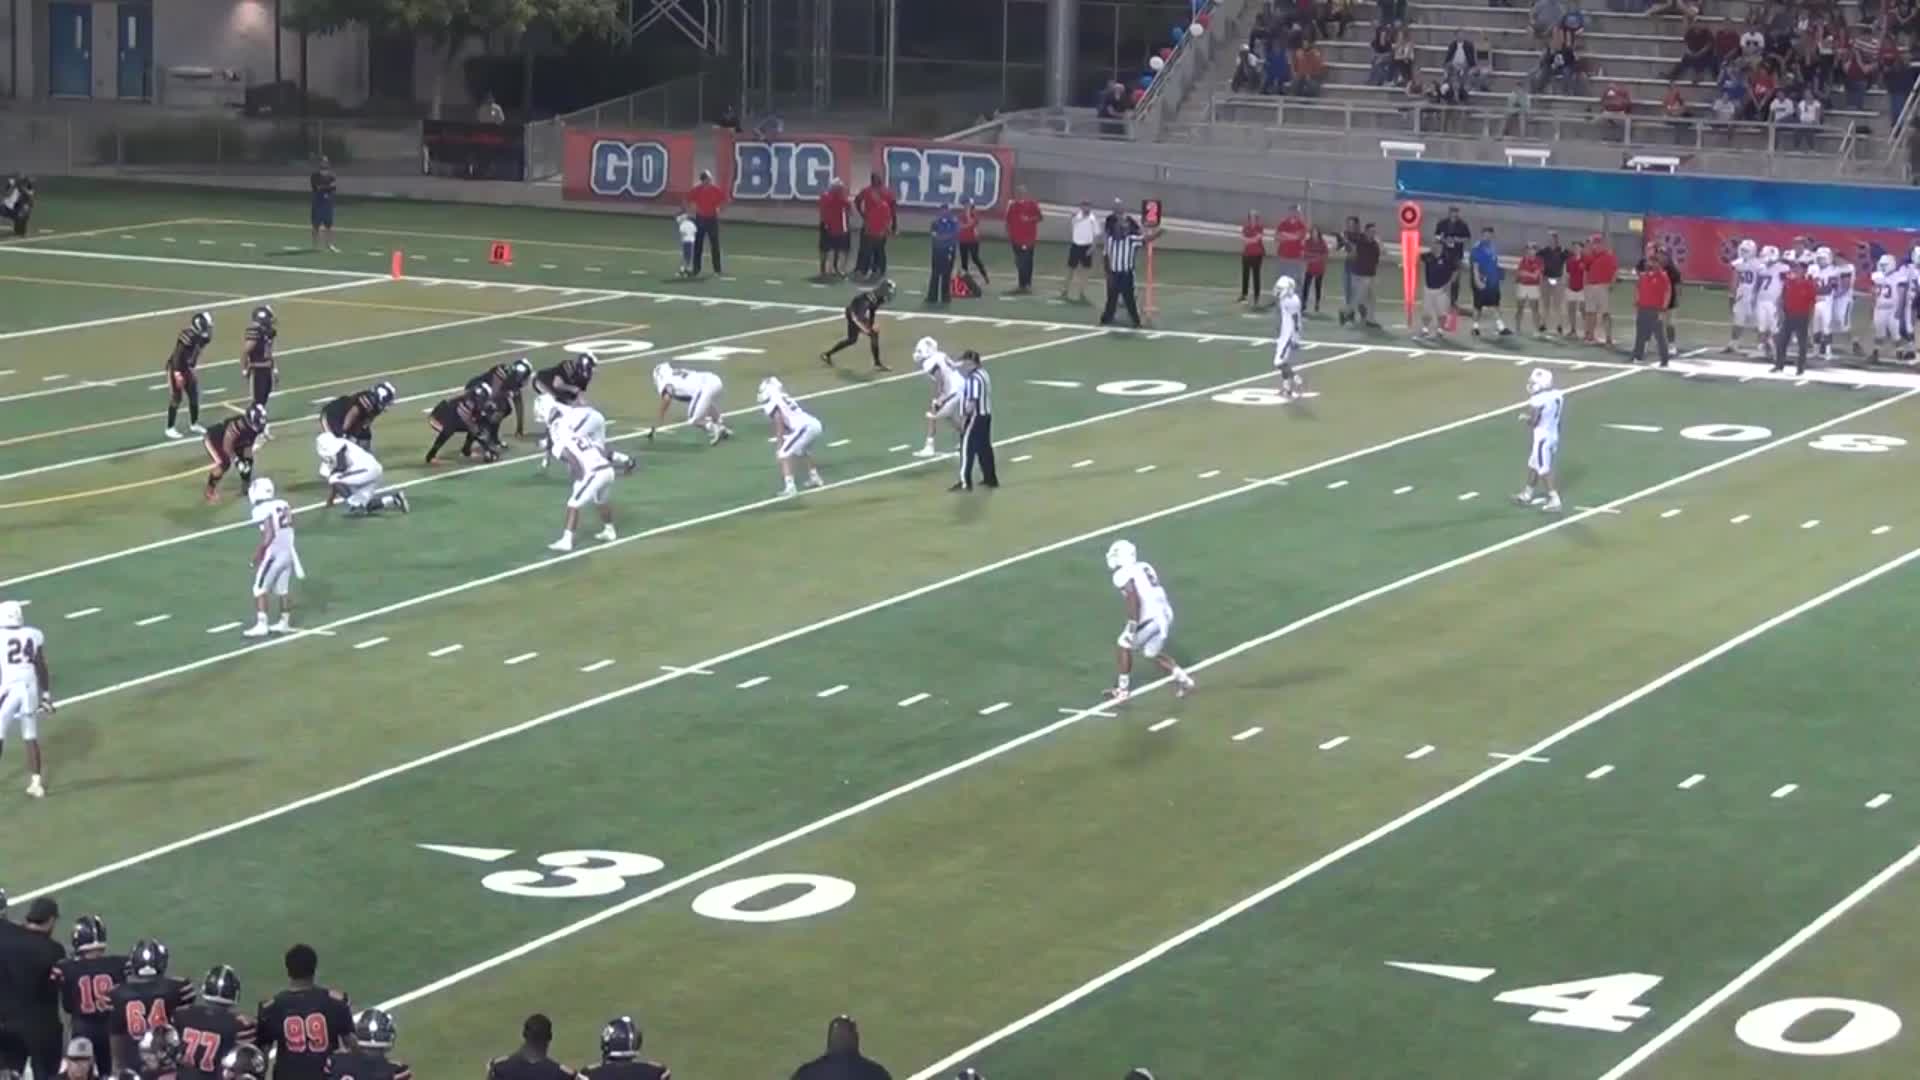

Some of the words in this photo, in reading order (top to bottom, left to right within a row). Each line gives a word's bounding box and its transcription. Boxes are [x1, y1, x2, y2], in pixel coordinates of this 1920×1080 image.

[590, 140, 668, 198] GO
[732, 142, 836, 200] BIG
[883, 147, 1002, 209] RED
[7, 637, 36, 665] 24
[126, 997, 168, 1040] 64
[282, 1012, 329, 1053] 99
[183, 1026, 222, 1072] 77
